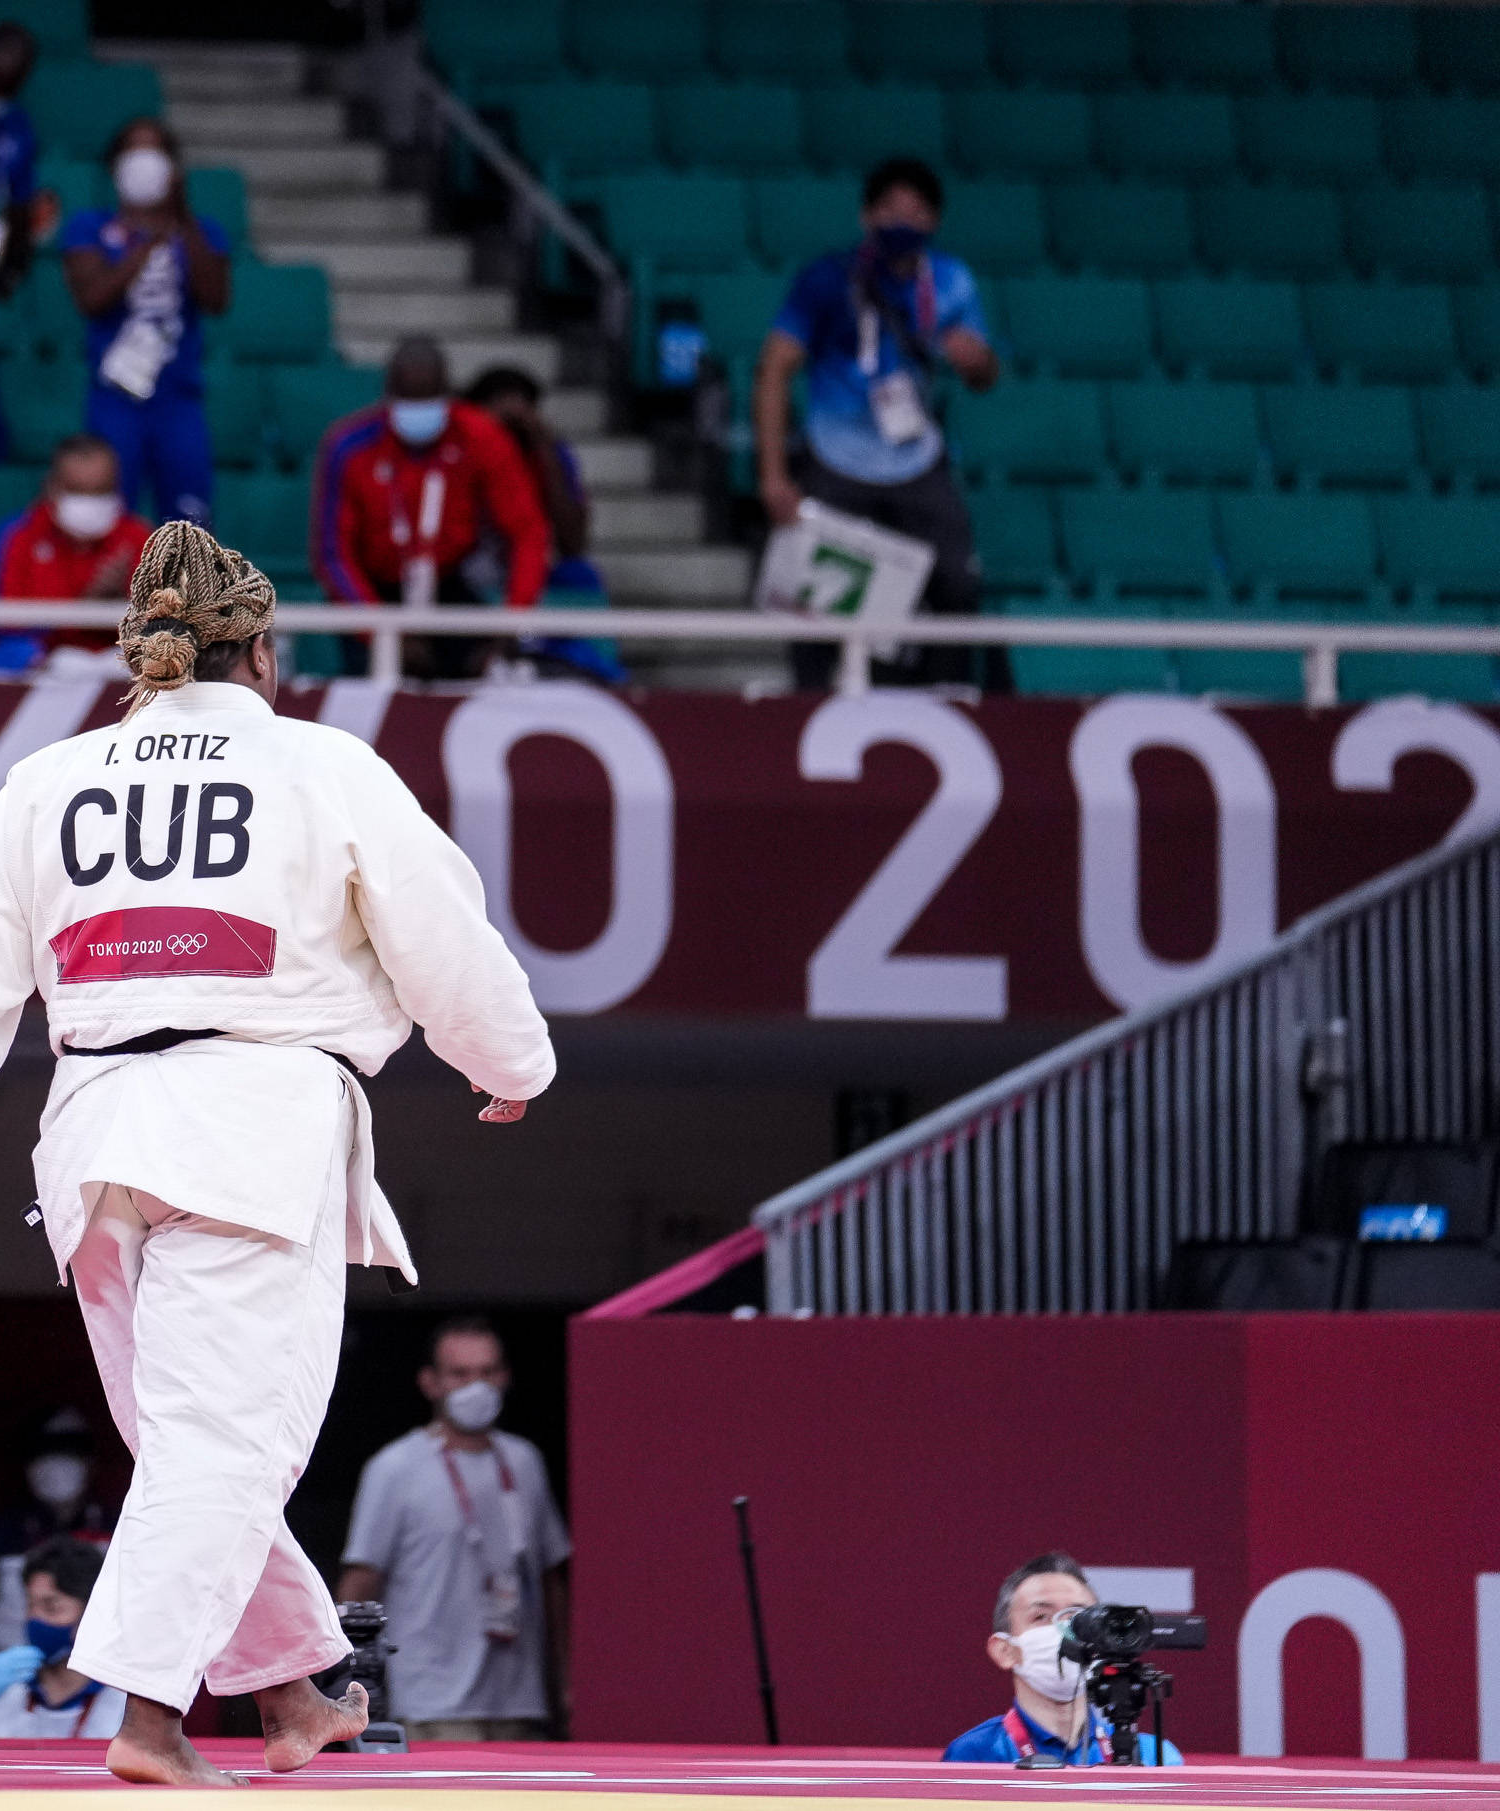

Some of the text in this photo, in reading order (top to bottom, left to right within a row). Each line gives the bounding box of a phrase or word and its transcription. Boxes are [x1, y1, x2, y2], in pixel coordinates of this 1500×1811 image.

[104, 733, 230, 766] I. ORTIZ
[60, 781, 254, 887] CUB
[86, 939, 163, 957] TOKYO 2020
